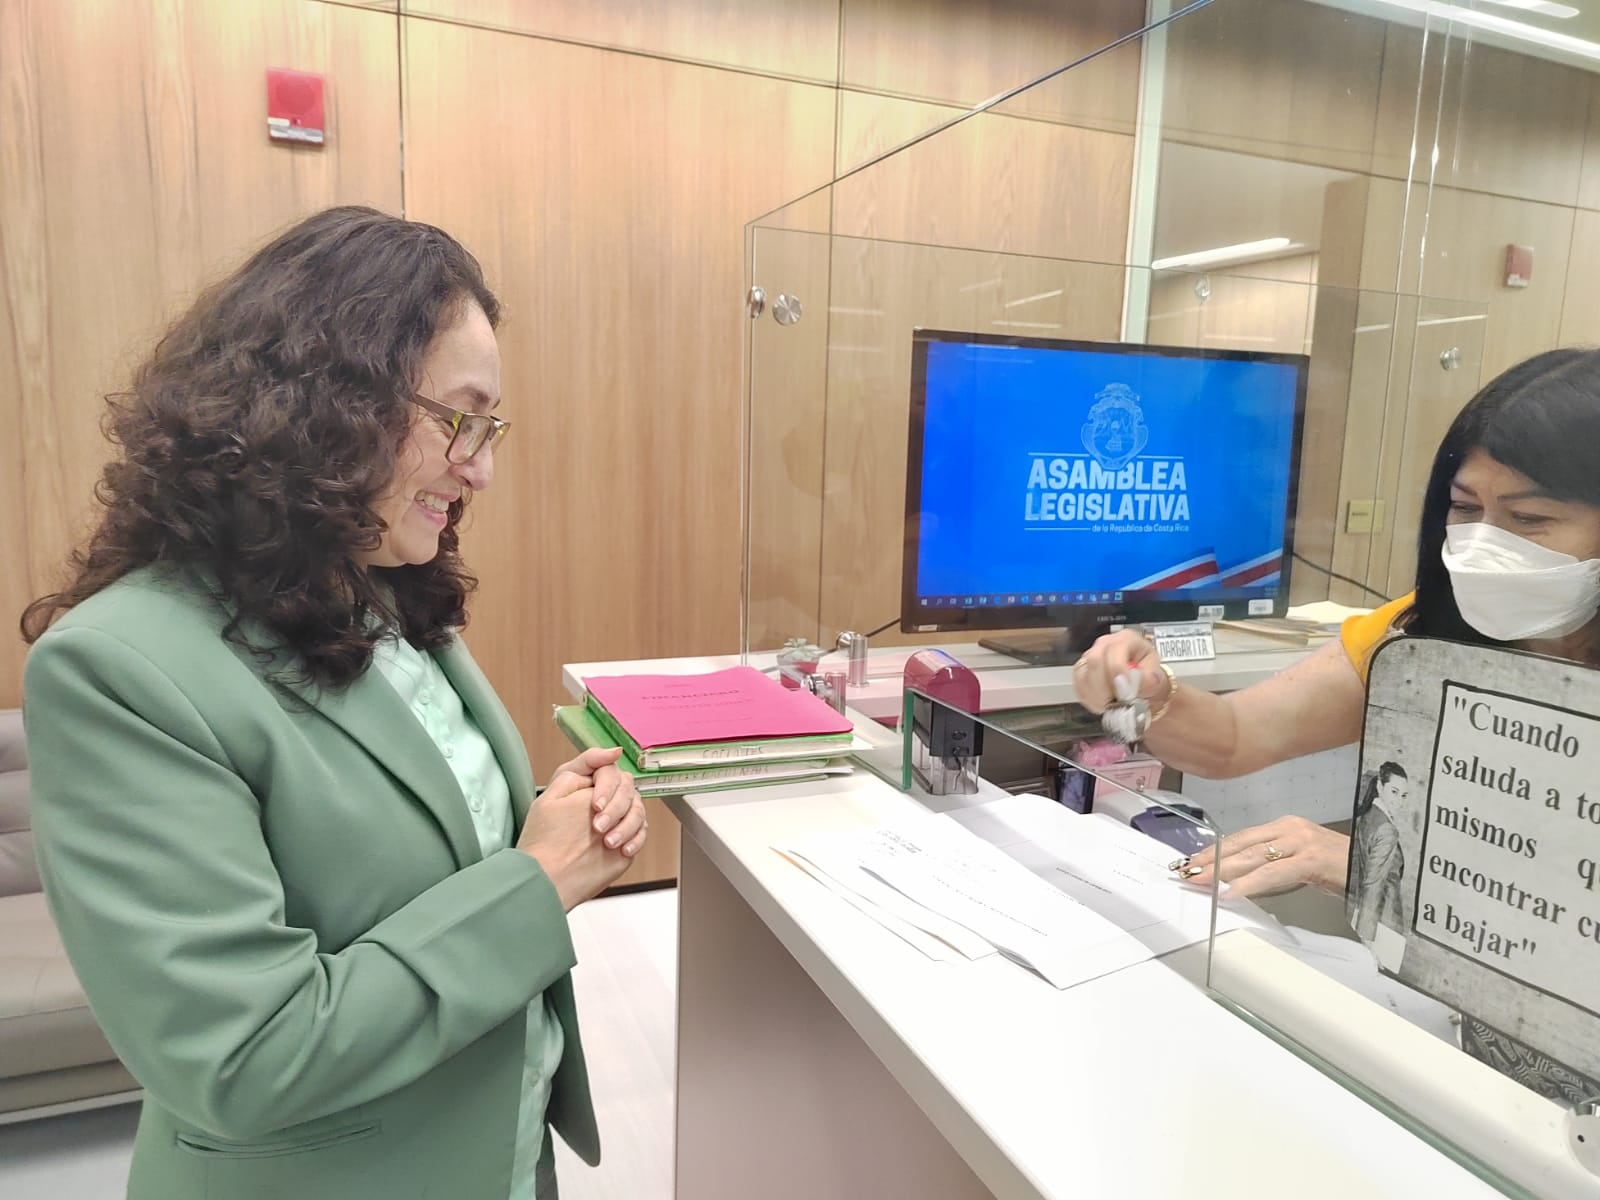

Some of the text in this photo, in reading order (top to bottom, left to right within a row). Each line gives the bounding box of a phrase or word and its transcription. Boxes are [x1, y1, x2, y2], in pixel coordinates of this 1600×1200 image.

[1027, 458, 1187, 491] ASAMBLEA
[1024, 492, 1191, 521] LEGISLATIVA
[1092, 524, 1101, 532] de
[1154, 524, 1174, 533] Costa
[1175, 524, 1190, 532] Rica
[1454, 696, 1579, 758] "Cuando
[1441, 754, 1531, 800] saluda
[1545, 787, 1561, 810] a
[1435, 805, 1600, 891] mismos q
[1429, 854, 1566, 925] encontrar
[1423, 903, 1537, 960] a bajar"
